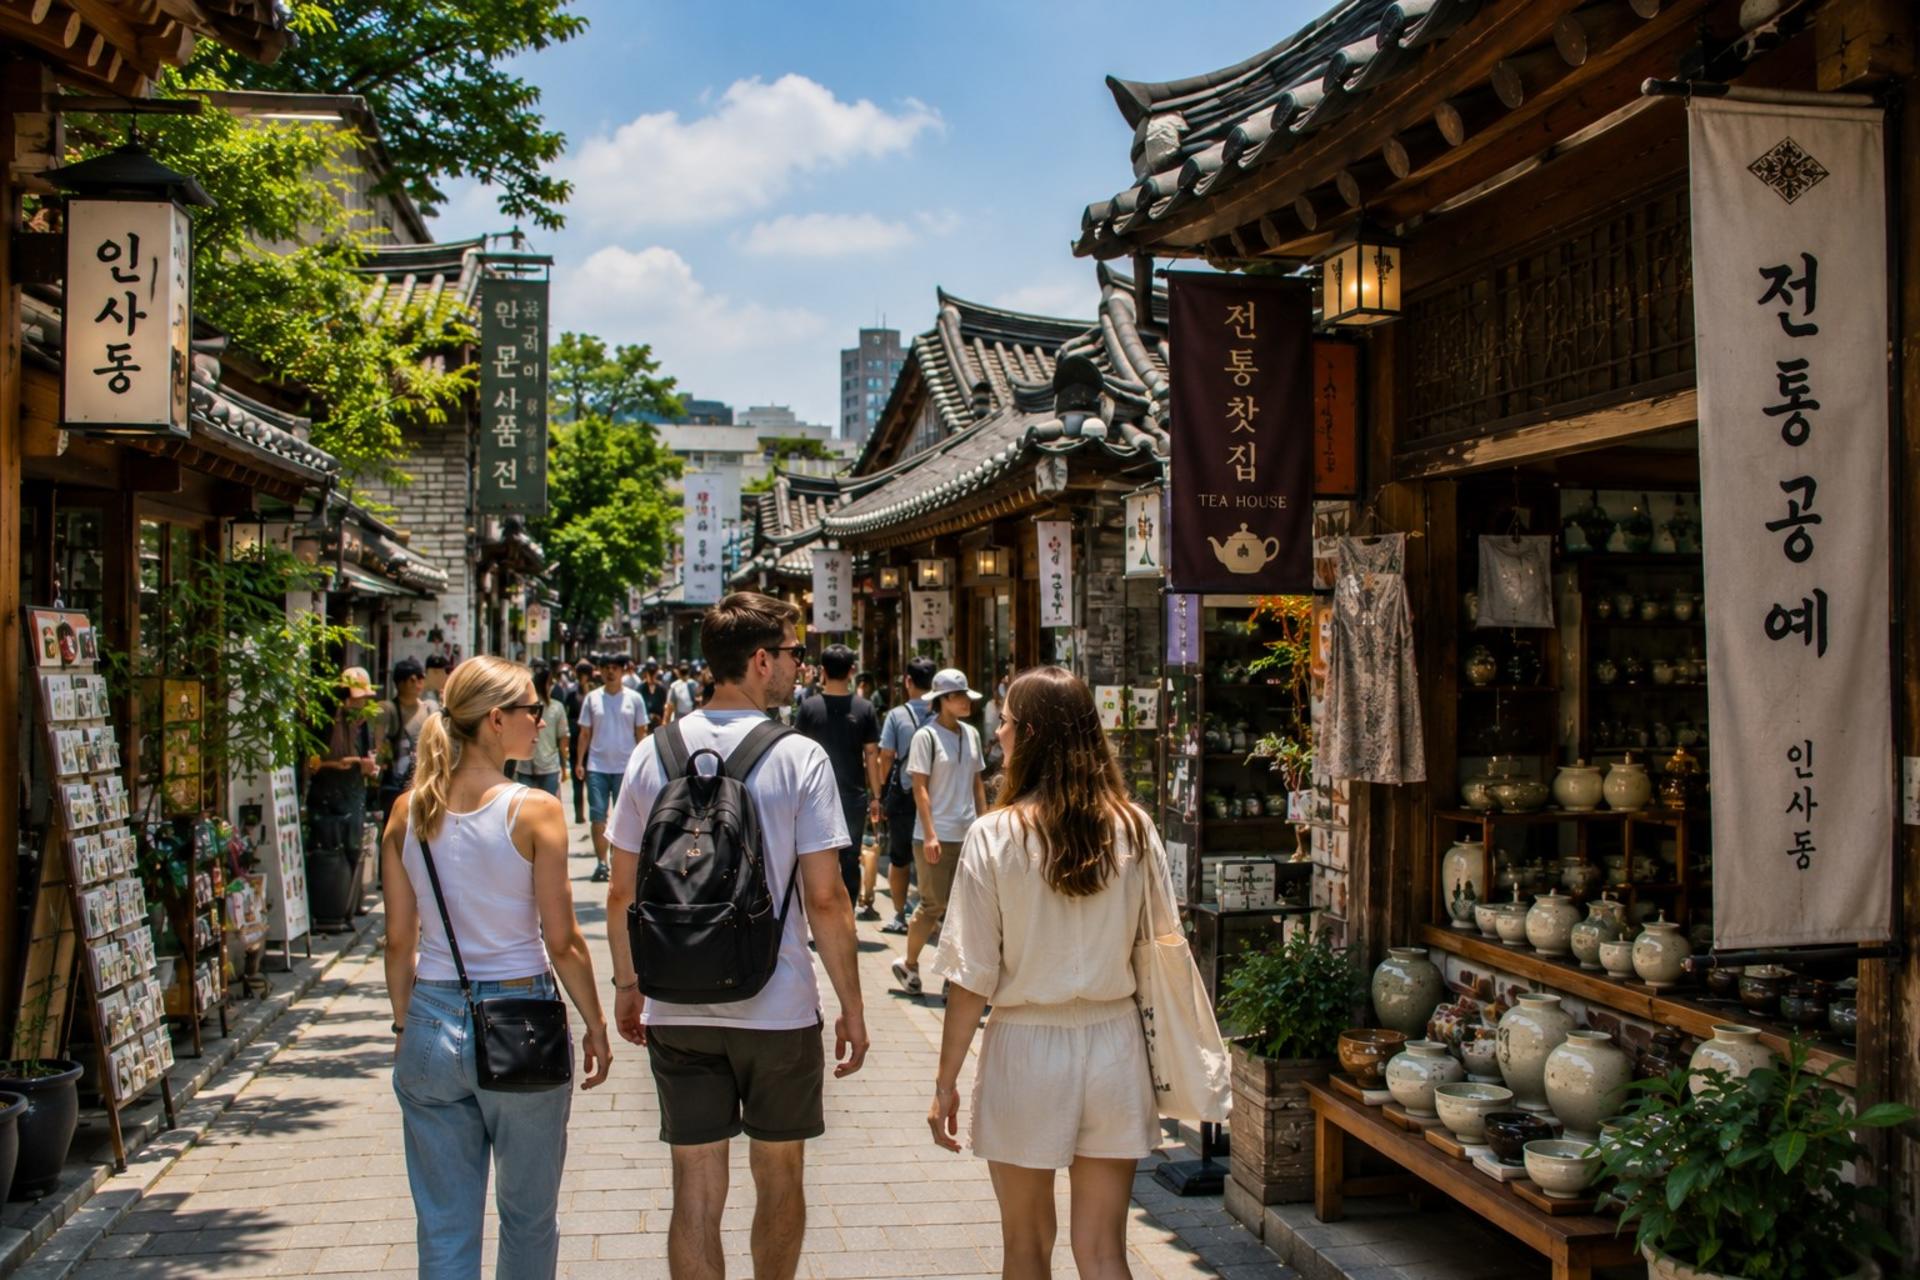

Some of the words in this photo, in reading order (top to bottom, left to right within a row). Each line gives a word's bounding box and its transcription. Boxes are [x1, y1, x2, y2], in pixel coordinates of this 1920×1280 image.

[93, 231, 148, 395] 인사동
[1223, 300, 1260, 483] 전통찻집
[1197, 493, 1229, 509] TEA
[1235, 494, 1288, 509] HOUSE
[1757, 251, 1829, 659] 전통공예
[1784, 738, 1819, 871] 인사동
